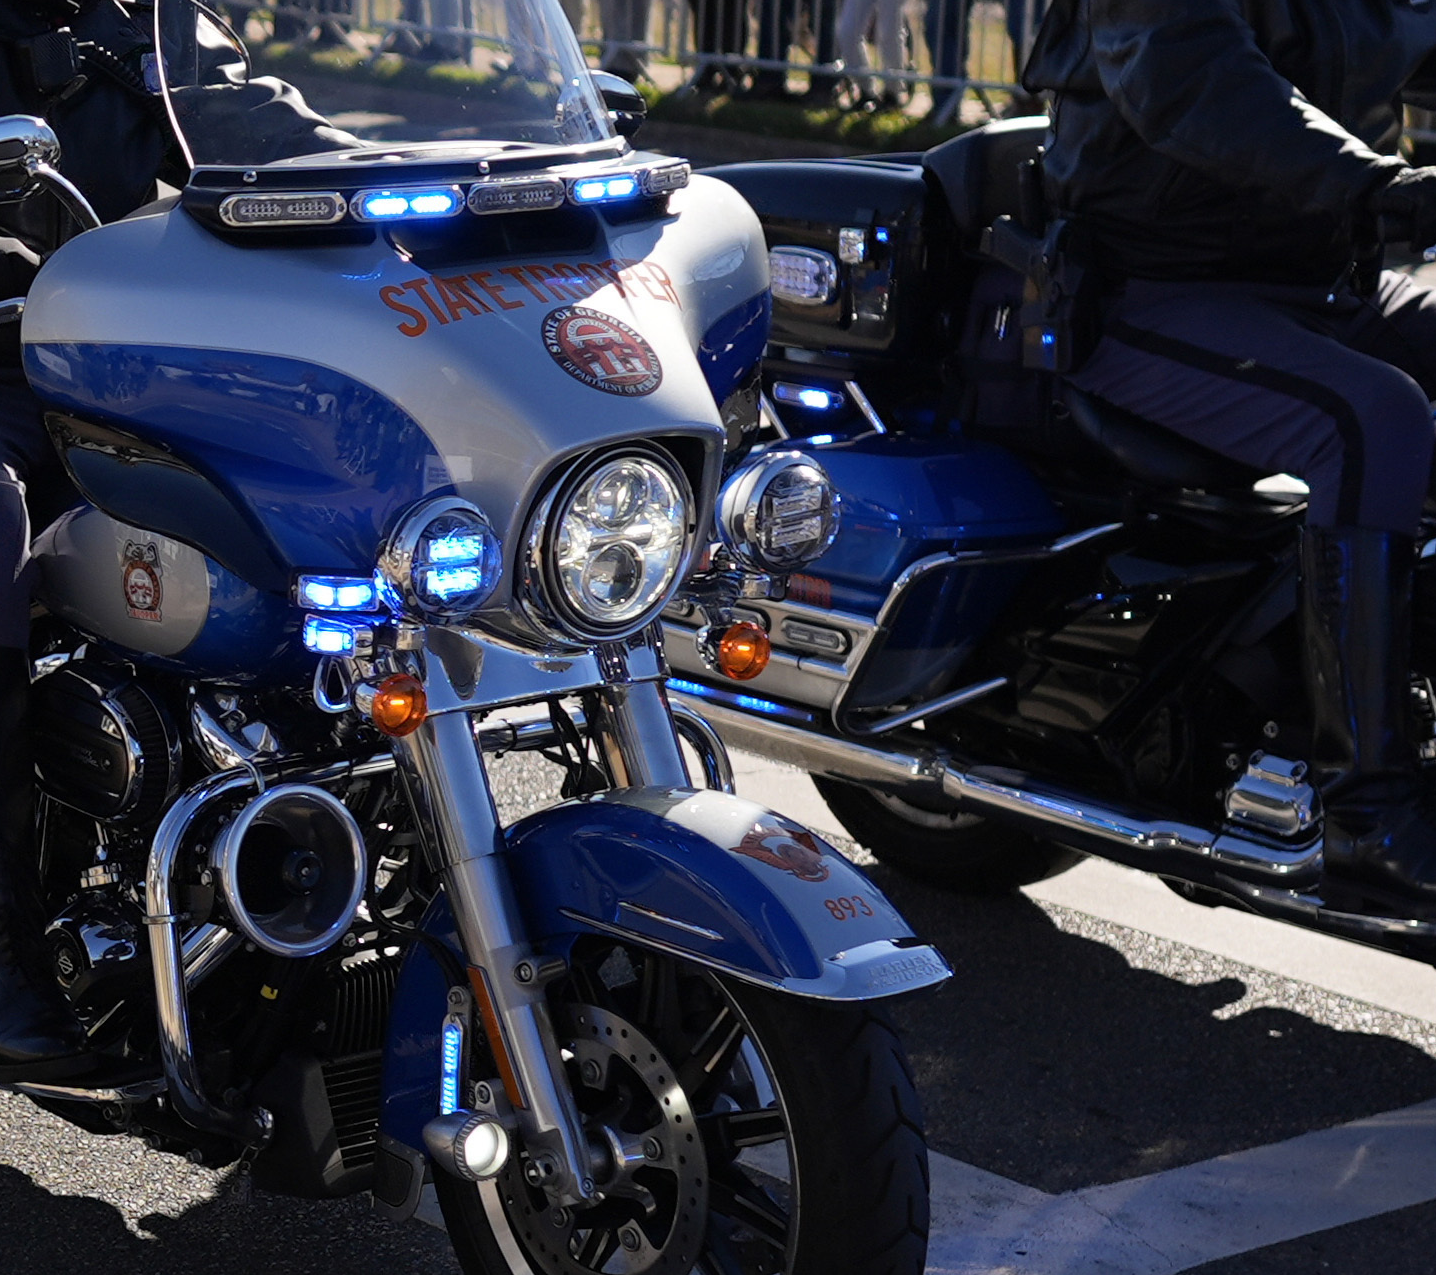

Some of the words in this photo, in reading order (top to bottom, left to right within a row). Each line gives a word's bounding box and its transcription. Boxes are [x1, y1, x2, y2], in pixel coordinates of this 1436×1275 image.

[379, 270, 526, 338] STATE
[497, 258, 684, 312] TROOPER
[544, 318, 562, 354] STATE
[554, 308, 573, 320] OF
[574, 307, 644, 344] GEORGIA
[562, 361, 624, 394] DEPARTMENT
[823, 895, 876, 922] 893
